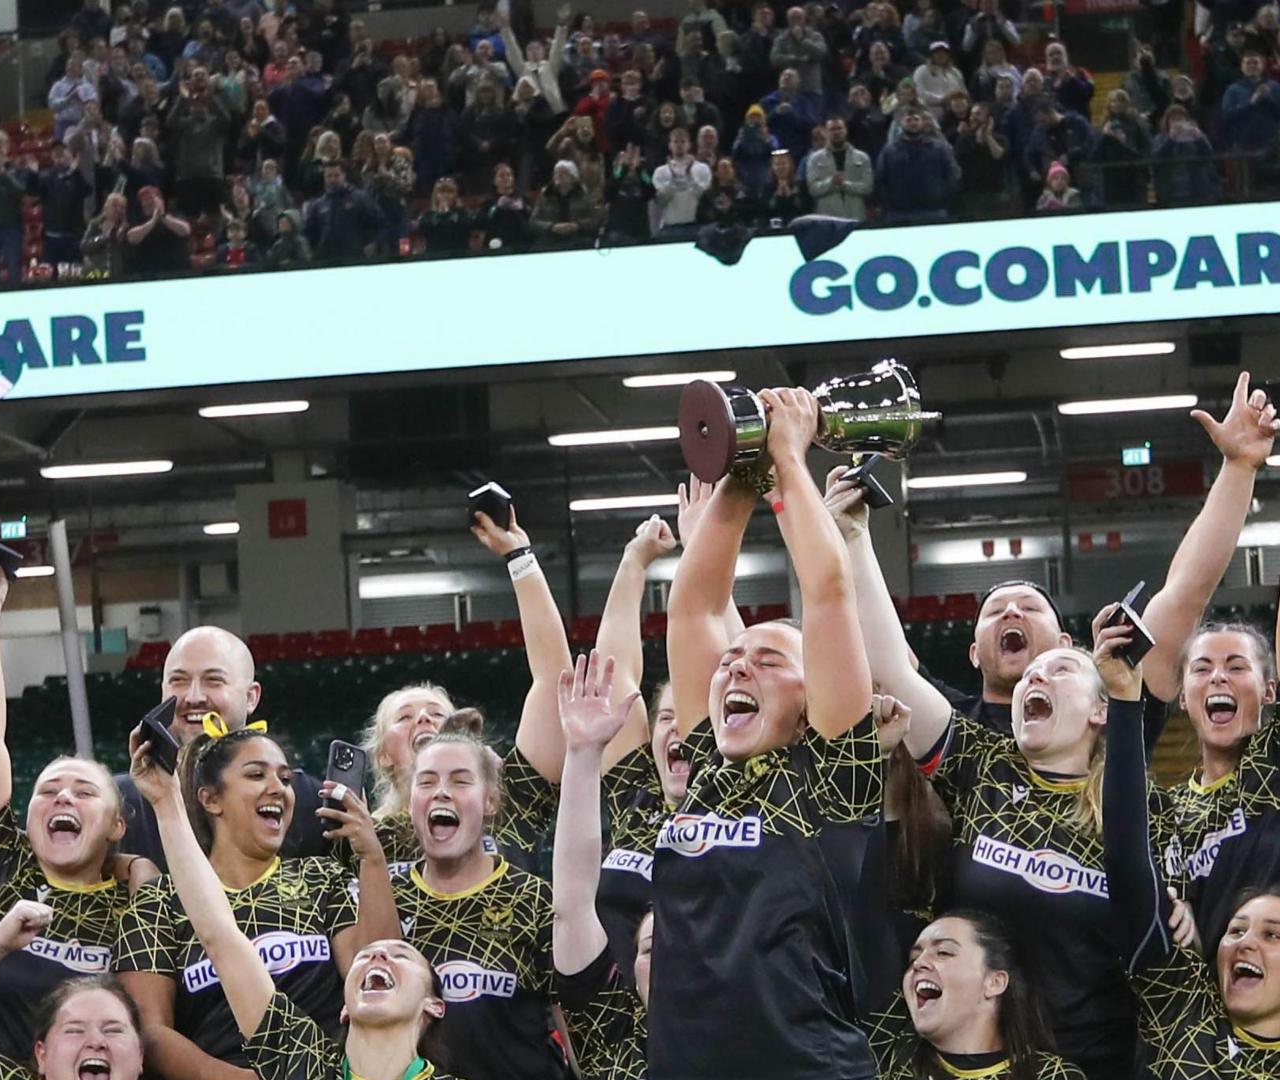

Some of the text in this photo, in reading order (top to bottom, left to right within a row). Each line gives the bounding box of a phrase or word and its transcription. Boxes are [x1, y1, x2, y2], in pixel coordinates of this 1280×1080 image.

[1105, 466, 1166, 497] 308
[975, 839, 1109, 894] HIGH MOTIVE
